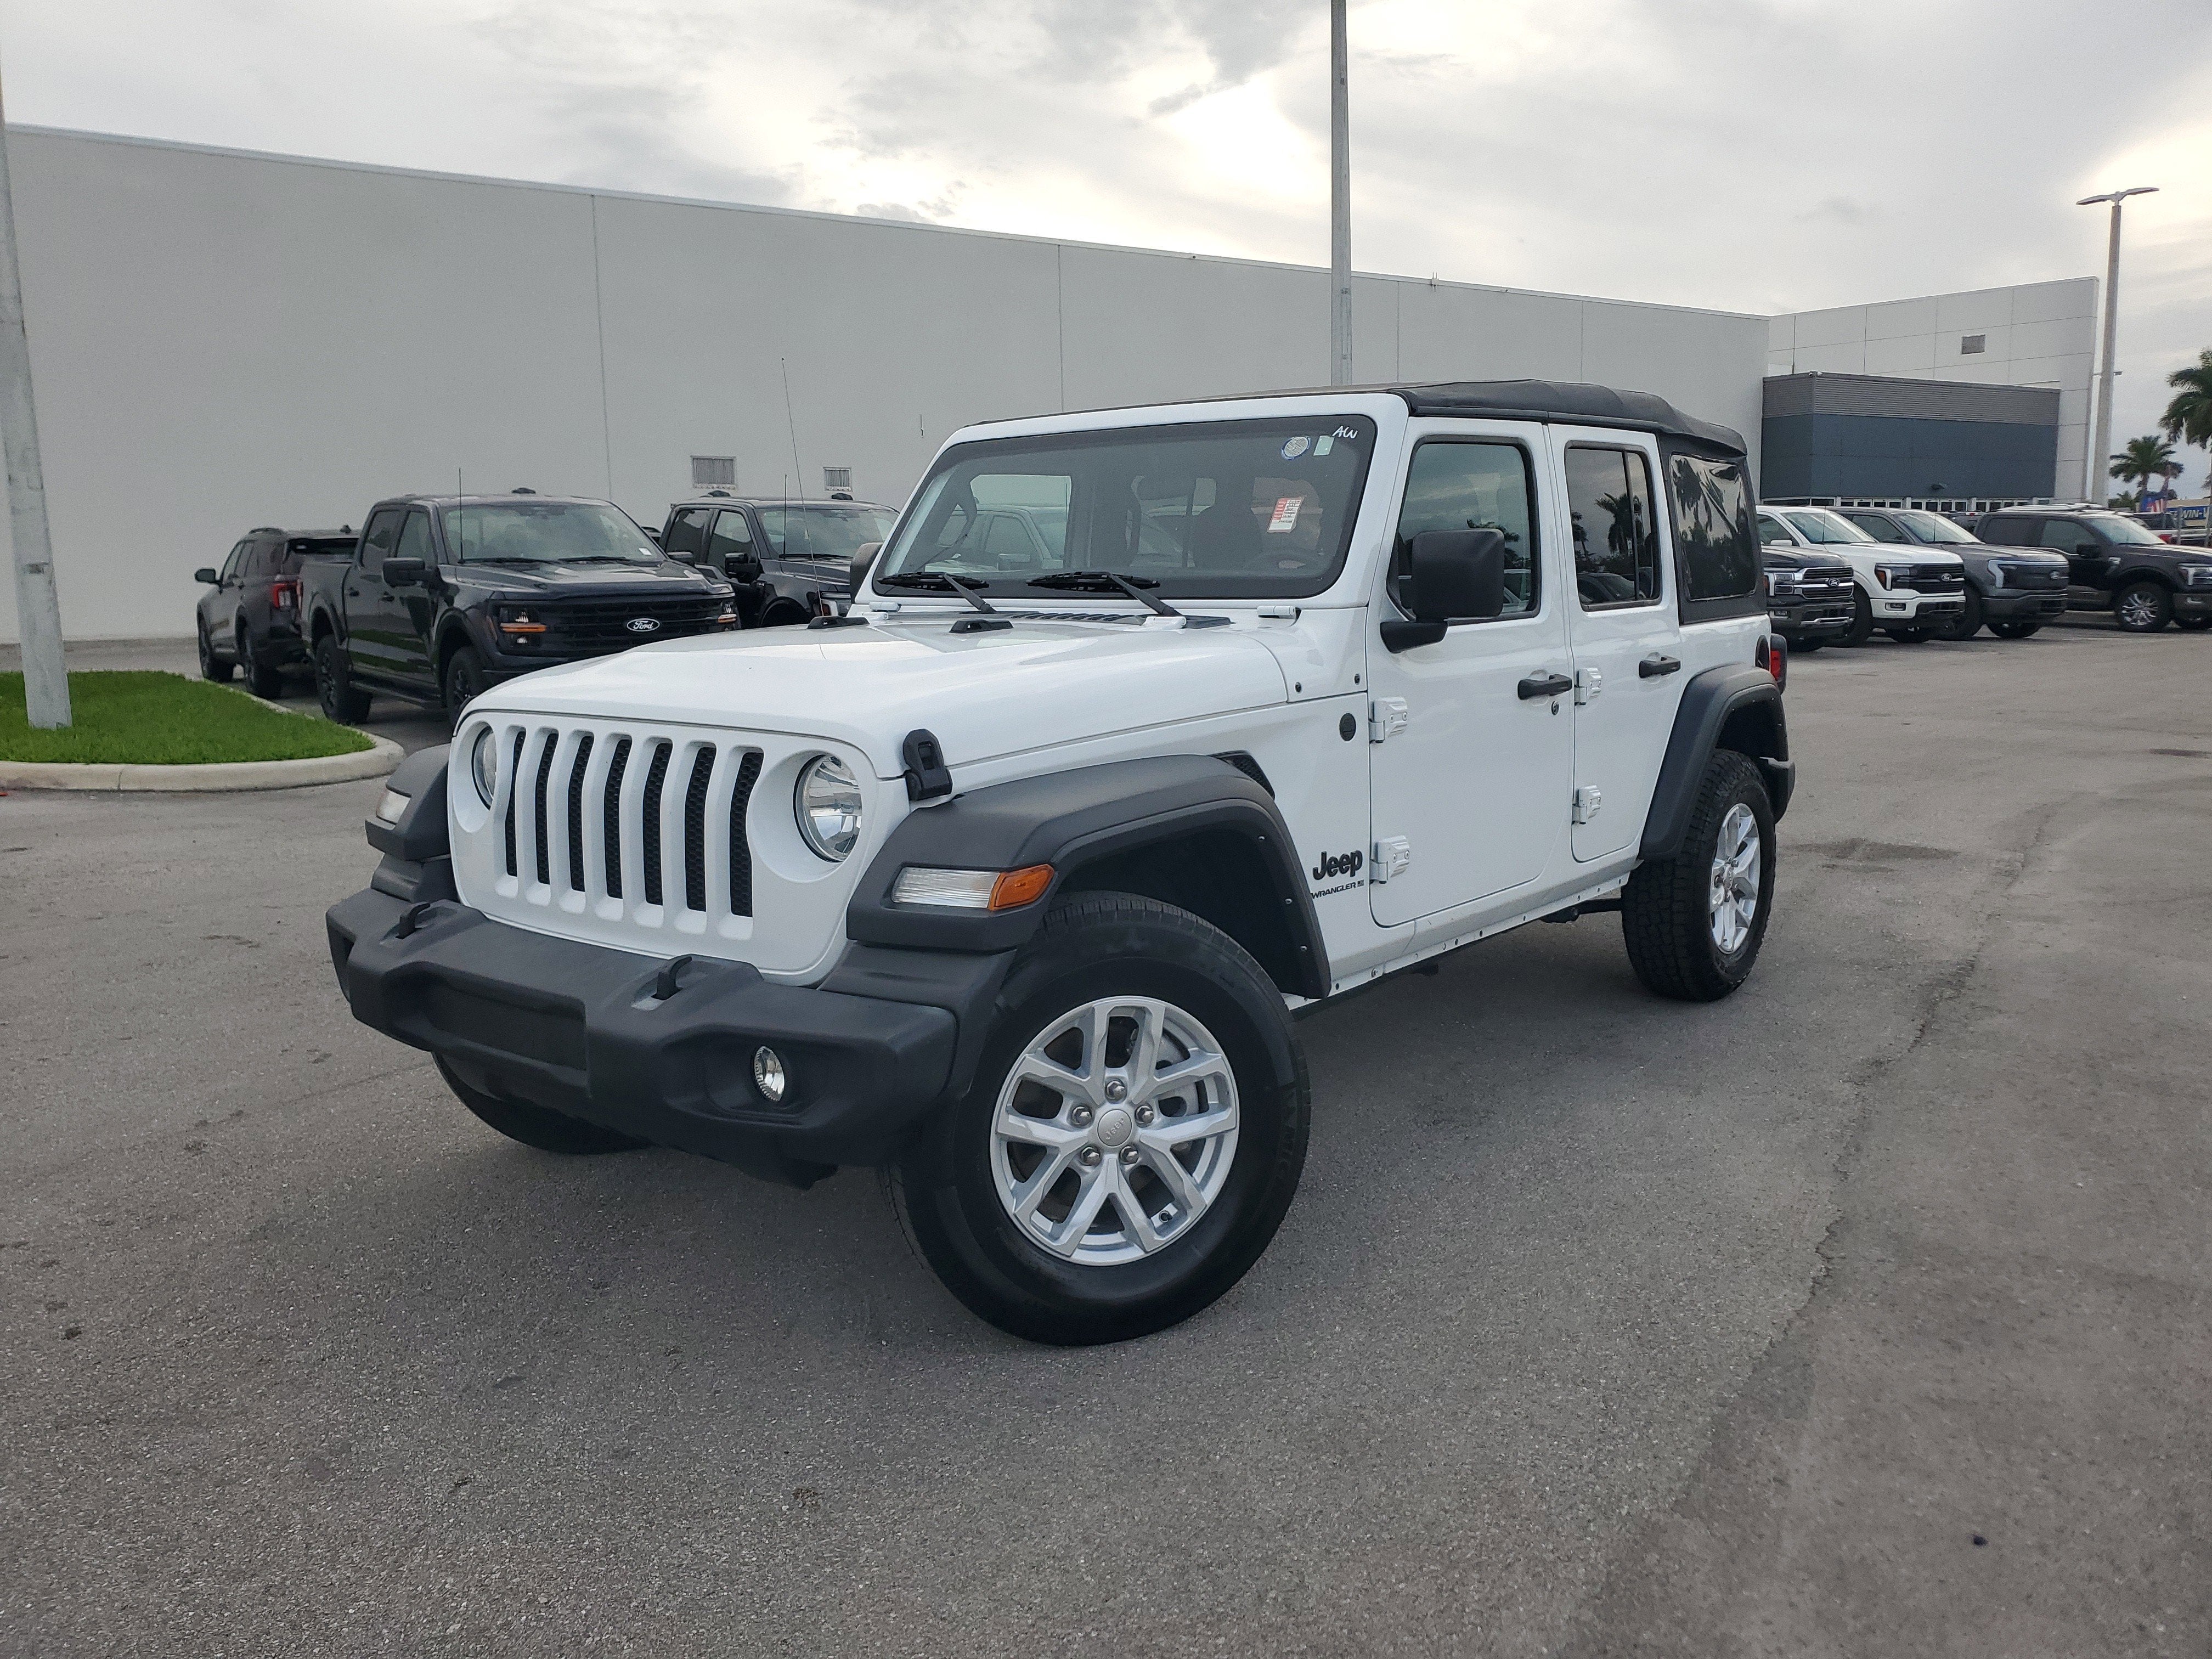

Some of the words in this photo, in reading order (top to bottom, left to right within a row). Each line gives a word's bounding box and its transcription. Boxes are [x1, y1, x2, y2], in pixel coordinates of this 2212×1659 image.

[633, 620, 653, 629] Ford
[1313, 850, 1363, 880] Jeep
[1311, 882, 1356, 899] WRANGLER
[1106, 1117, 1125, 1140] Jeep
